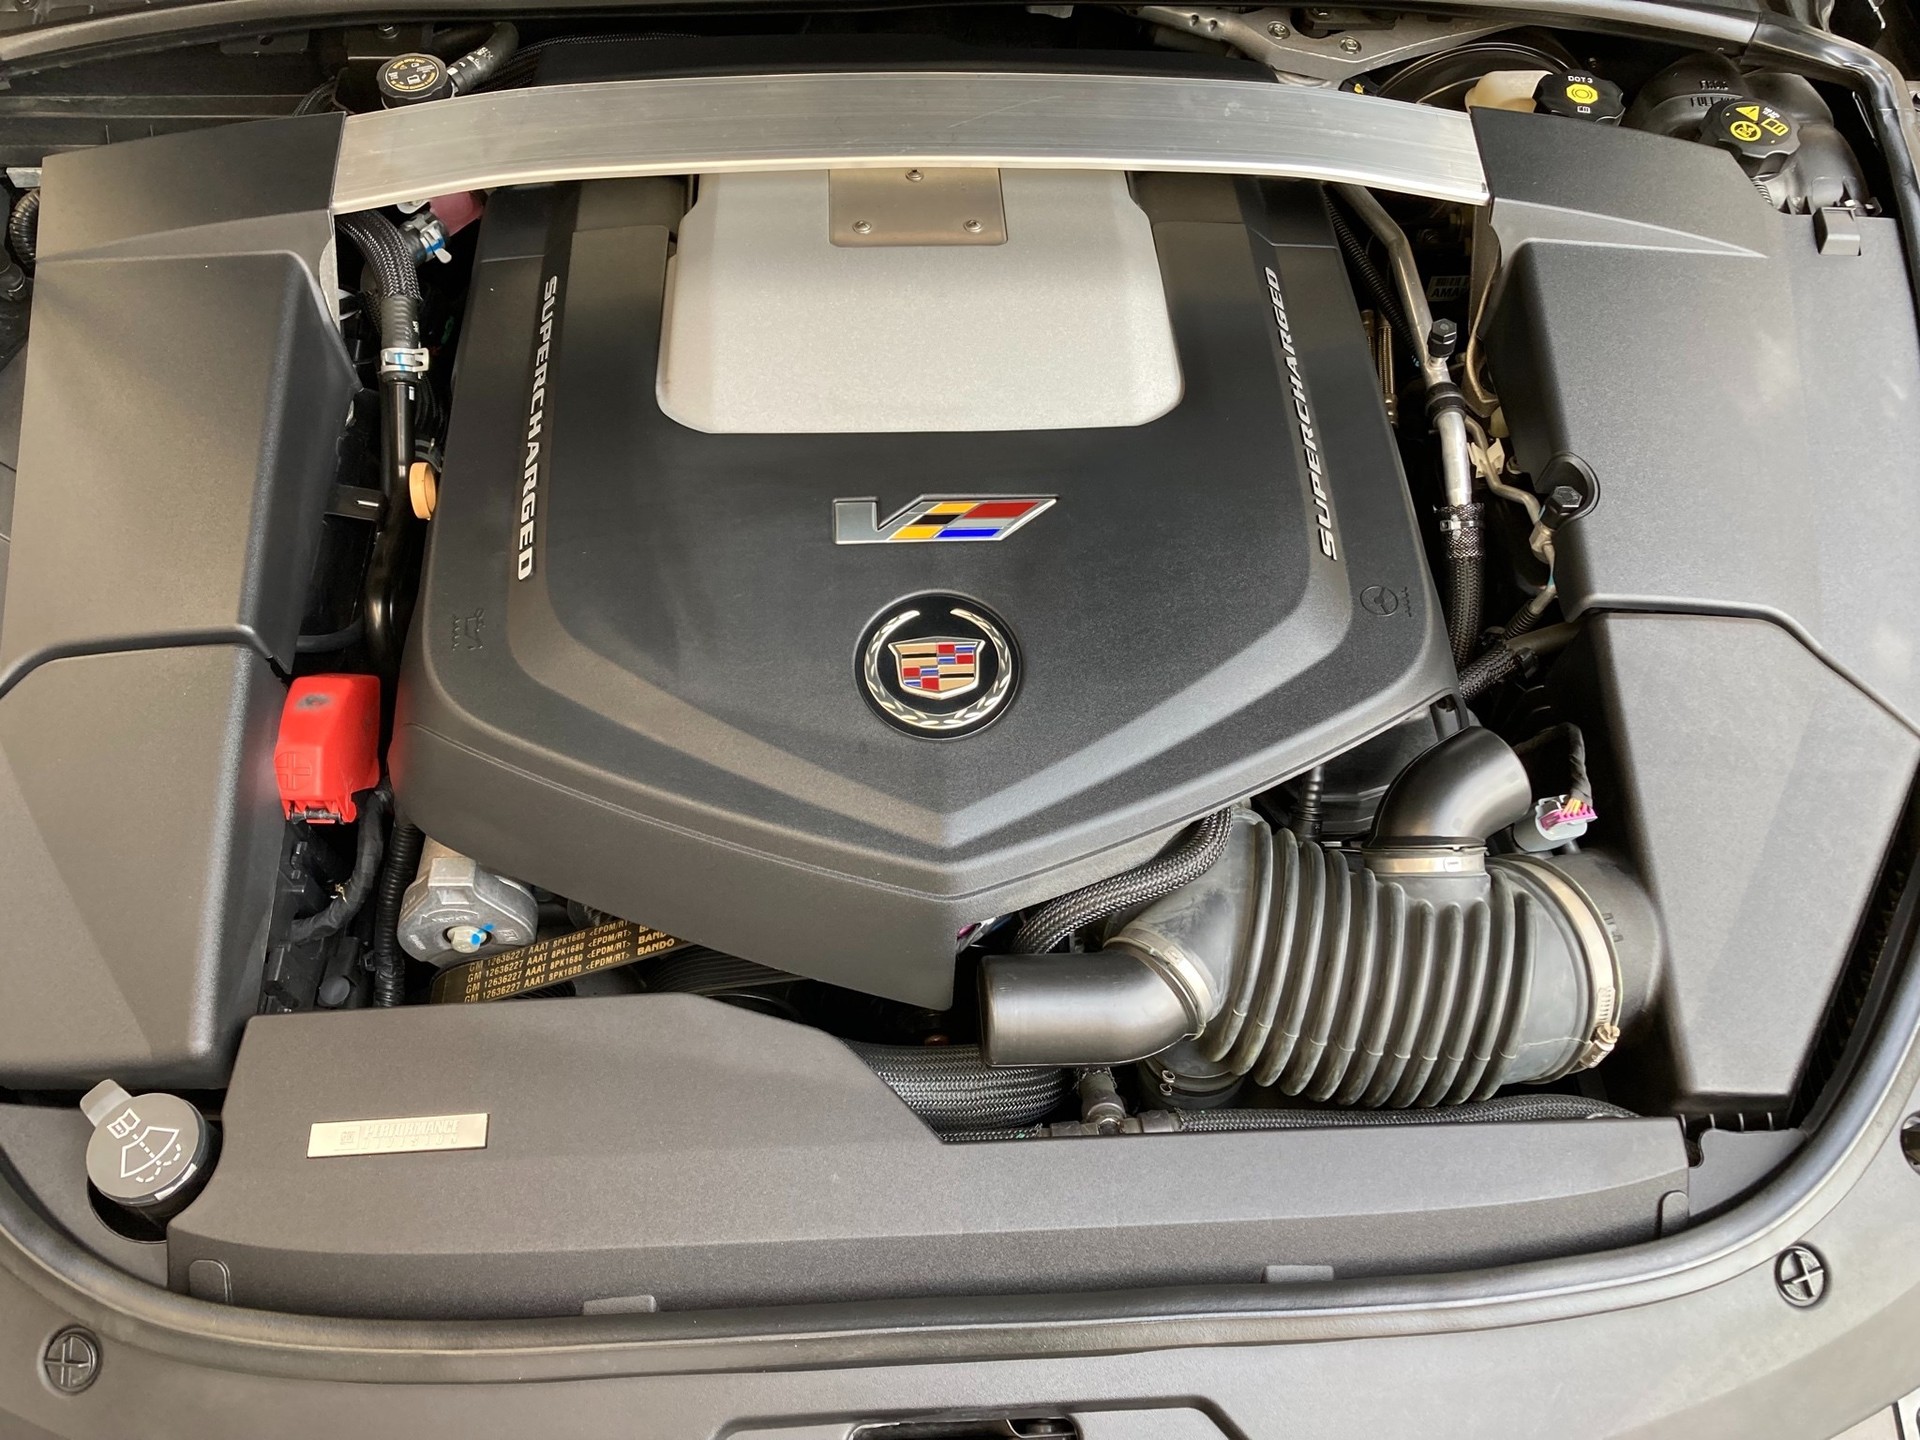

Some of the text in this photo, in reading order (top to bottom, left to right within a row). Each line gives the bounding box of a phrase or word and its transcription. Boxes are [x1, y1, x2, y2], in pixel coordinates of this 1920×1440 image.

[1567, 75, 1586, 83] DOT
[517, 275, 558, 581] SUPERCHARGED
[1264, 266, 1338, 561] SUPERCHARGED
[464, 993, 479, 1003] GM
[482, 982, 521, 999] 12636227
[523, 975, 545, 989] AAAT
[548, 964, 582, 981] 8PK1680
[637, 938, 675, 956] BANDO
[465, 982, 480, 994] GM
[484, 971, 523, 988] 12636227
[525, 963, 547, 977] AAAT
[549, 953, 583, 970] 8PK1680
[637, 931, 667, 945] BAND
[467, 972, 482, 983] GM
[485, 960, 524, 977] 12636227
[527, 952, 548, 966] AAAT
[551, 942, 585, 959] 8PK1680
[469, 960, 484, 972] GM
[589, 919, 629, 936] <EPDM/RT
